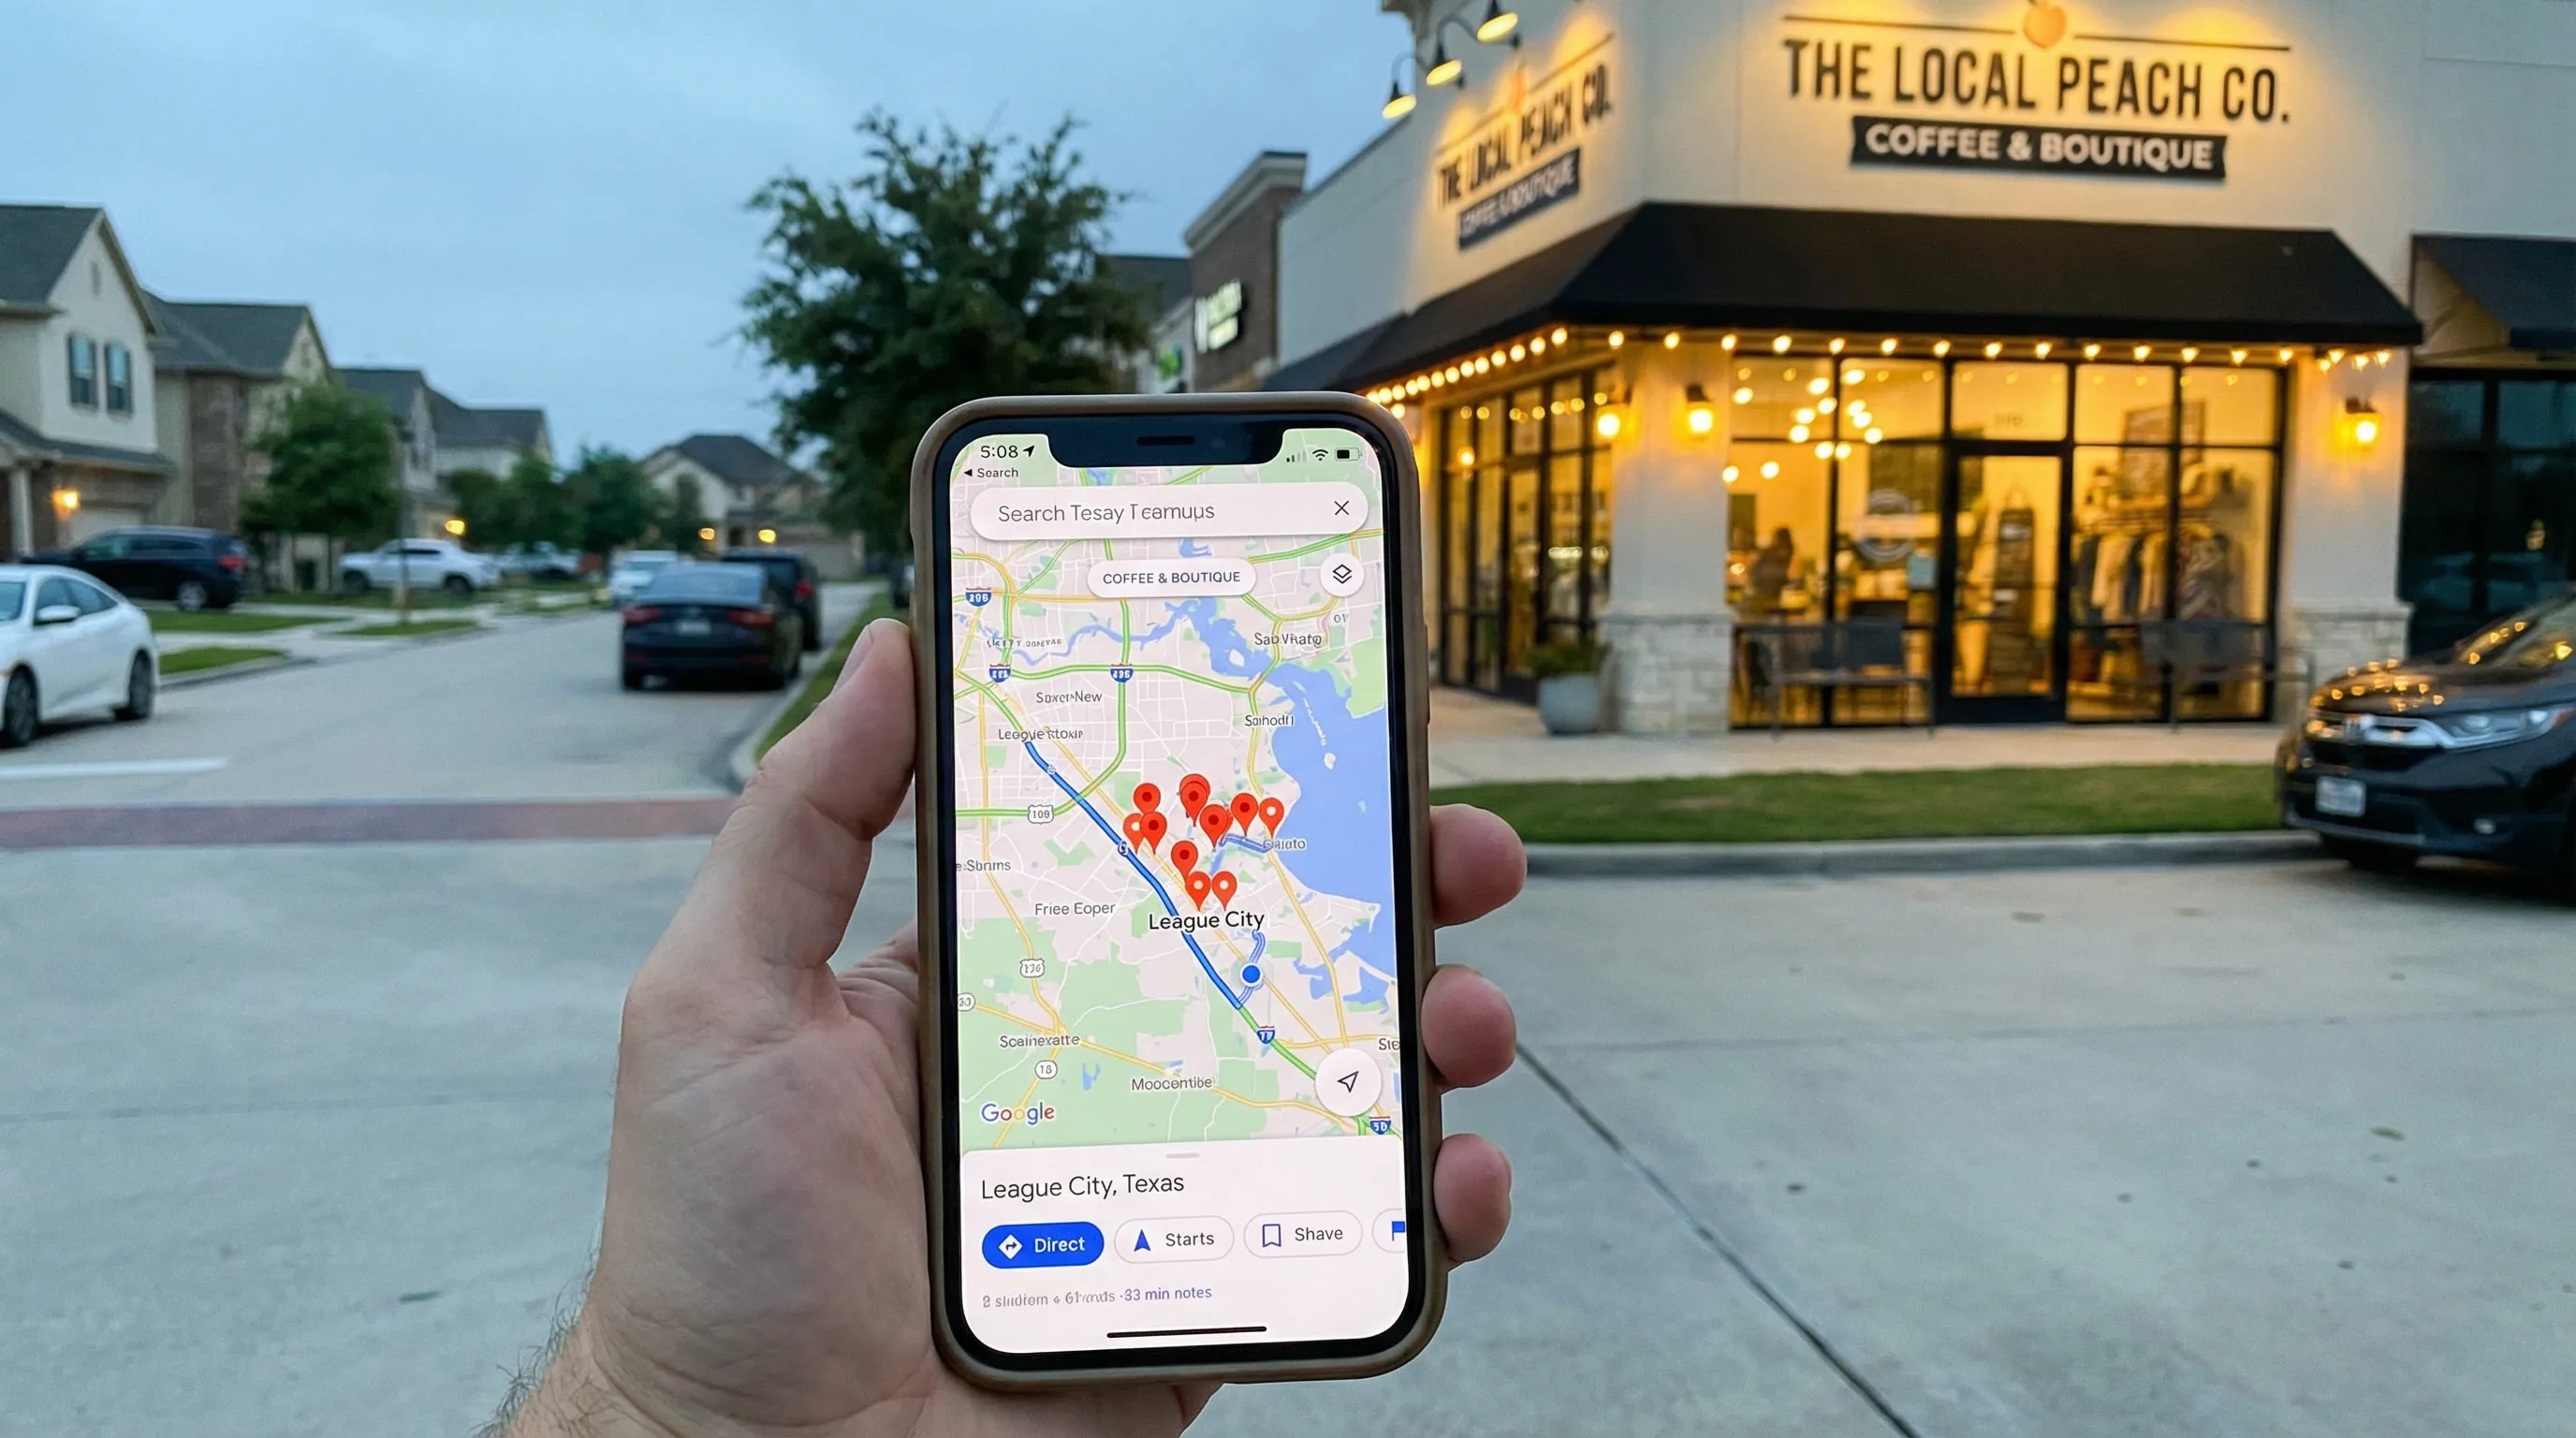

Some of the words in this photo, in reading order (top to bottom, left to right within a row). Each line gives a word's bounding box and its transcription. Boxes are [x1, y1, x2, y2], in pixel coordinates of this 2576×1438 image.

[1783, 39, 1873, 100] THE
[1894, 45, 2036, 110] LOCAL
[2058, 56, 2203, 119] PEACH
[2222, 66, 2291, 123] CO.
[1865, 123, 1999, 159] COFFEE
[2007, 130, 2033, 162] &
[2040, 132, 2216, 172] BOUTIQUE
[980, 445, 1018, 459] 5:08
[977, 467, 1018, 478] Search
[998, 505, 1065, 521] Search
[1070, 505, 1124, 524] Tesay
[1103, 573, 1154, 584] COFFEE
[1158, 573, 1167, 583] &
[1171, 571, 1241, 583] BOUTIQUE
[1149, 914, 1220, 933] League
[1225, 910, 1265, 932] City
[981, 1102, 1056, 1125] Google
[982, 1180, 1062, 1203] League
[1068, 1176, 1118, 1199] City,
[1122, 1174, 1185, 1194] Texas
[1165, 1232, 1215, 1247] Starts
[1295, 1226, 1343, 1241] Shave
[1034, 1237, 1085, 1254] Direct
[1145, 1287, 1170, 1300] min
[1174, 1286, 1212, 1299] notes
